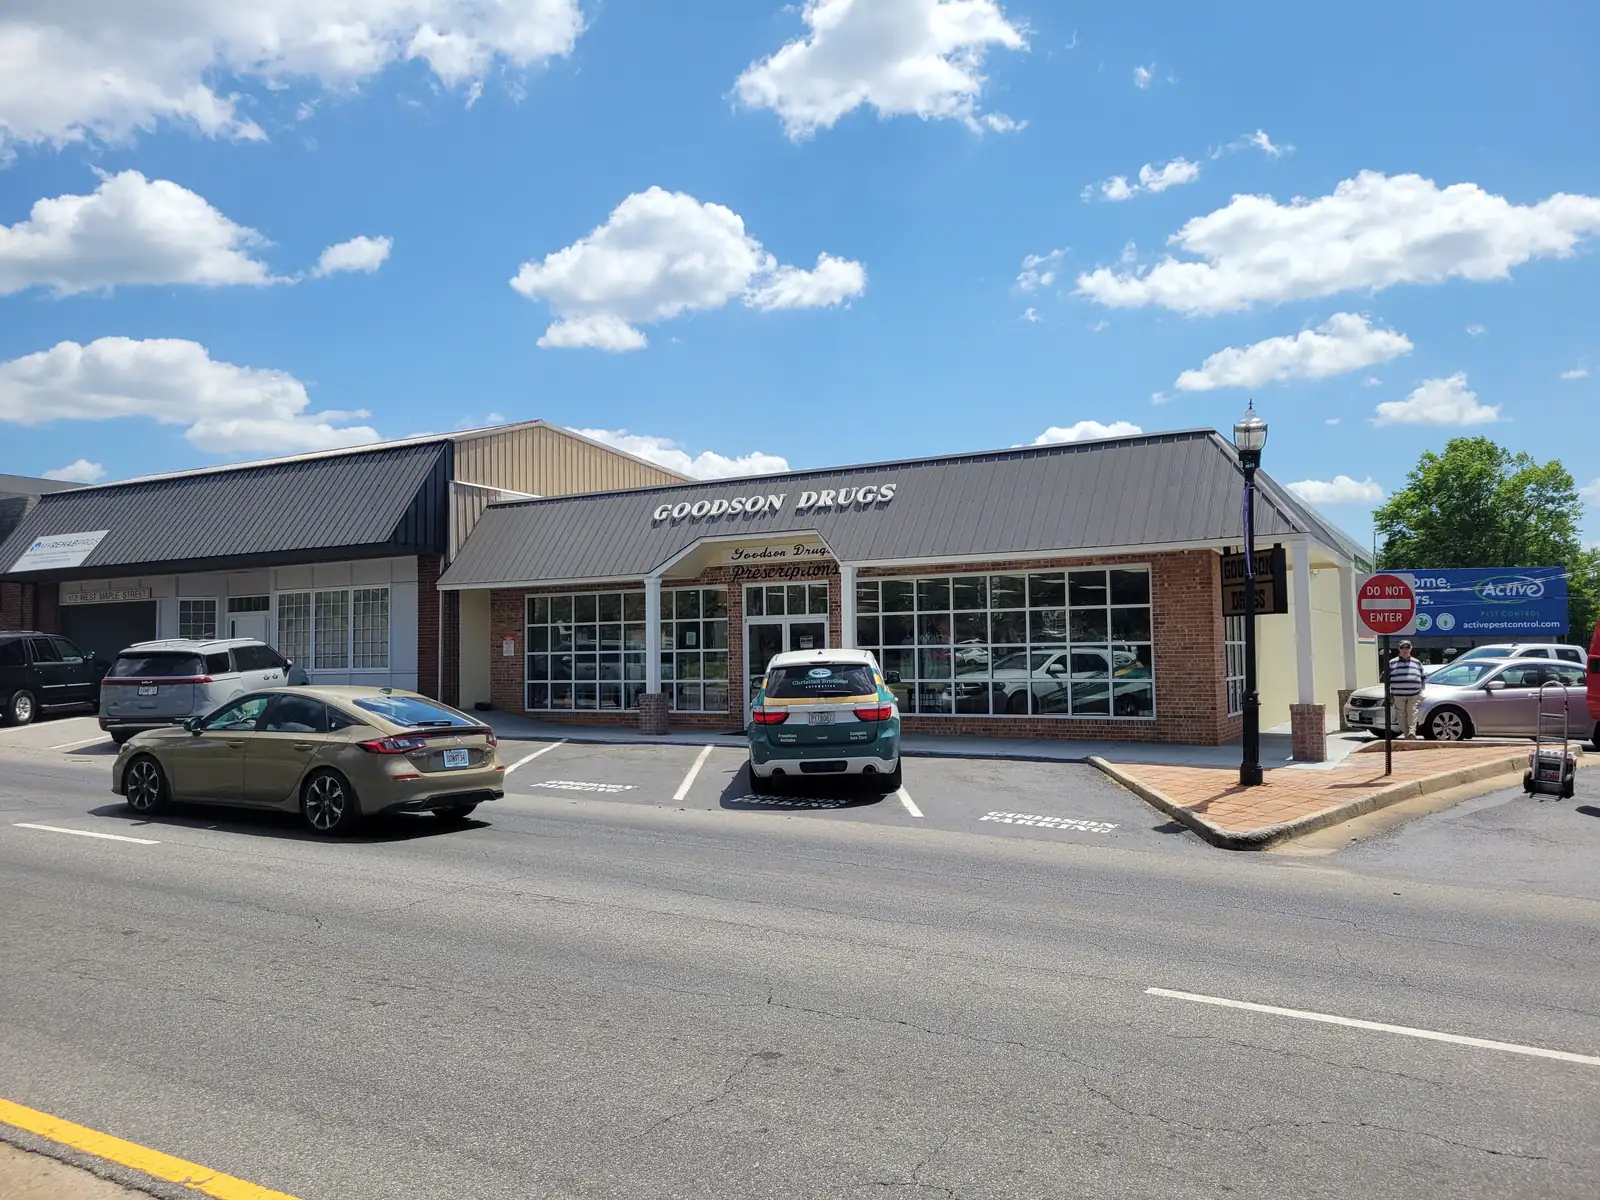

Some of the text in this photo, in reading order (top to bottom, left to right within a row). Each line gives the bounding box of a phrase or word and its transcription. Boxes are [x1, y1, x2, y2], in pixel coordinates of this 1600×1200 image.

[653, 484, 897, 521] GOODSON DRUGS
[731, 547, 787, 560] Goodson
[1224, 556, 1273, 579] GOOON
[1414, 577, 1451, 588] ome,
[1367, 586, 1405, 596] DO NOT
[1482, 581, 1544, 597] Active
[80, 592, 96, 601] WEST
[99, 591, 120, 600] MAPLE
[1231, 589, 1266, 610] DRGS
[1416, 595, 1434, 605] rs.
[1370, 613, 1403, 622] ENTER
[1463, 620, 1560, 629] activepestcontrol.com
